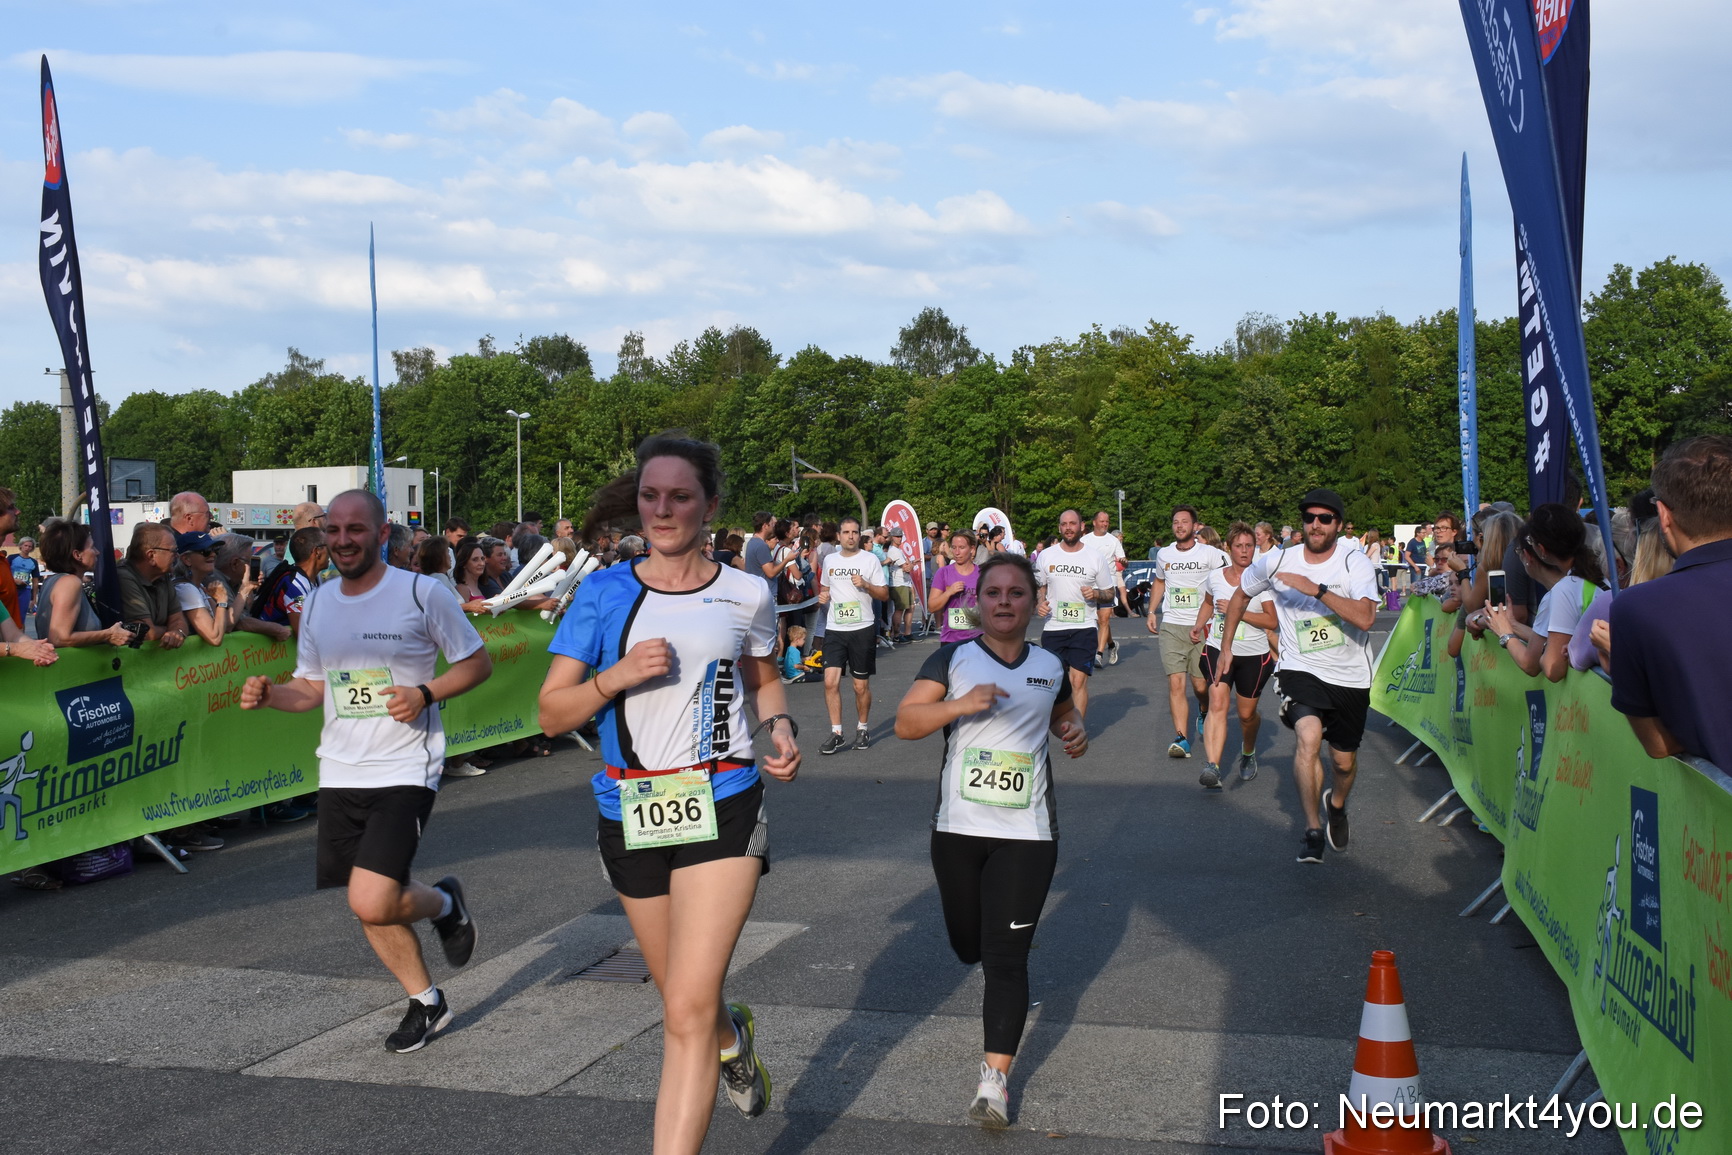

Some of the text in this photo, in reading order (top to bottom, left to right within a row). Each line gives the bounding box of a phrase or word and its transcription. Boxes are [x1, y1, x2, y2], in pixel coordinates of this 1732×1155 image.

[1055, 564, 1087, 576] GRADL
[1170, 561, 1202, 571] GRADL
[1174, 594, 1191, 603] 941
[838, 608, 855, 618] 942
[954, 615, 969, 624] 93
[1062, 608, 1079, 618] 943
[362, 632, 403, 641] auctores
[1310, 628, 1328, 643] 26
[175, 648, 240, 691] Gesunde
[242, 642, 288, 669] Firmen
[207, 680, 242, 714] laufe
[348, 687, 372, 705] 25
[710, 658, 735, 755] HUBER
[77, 700, 121, 723] Fischer
[85, 713, 122, 730] AUTOMOBILE
[692, 706, 700, 733] WATER
[36, 720, 187, 812] firmenlauf
[969, 767, 1024, 792] 2450
[142, 764, 305, 822] www.firmenlauf-oberpfalz.de
[37, 791, 108, 831] neumarkt
[633, 797, 702, 828] 1036
[637, 823, 702, 837] Bergmann Kristina
[1635, 832, 1656, 866] Fischer
[1614, 908, 1697, 1060] firmenlauf
[1609, 996, 1642, 1048] neumarkt
